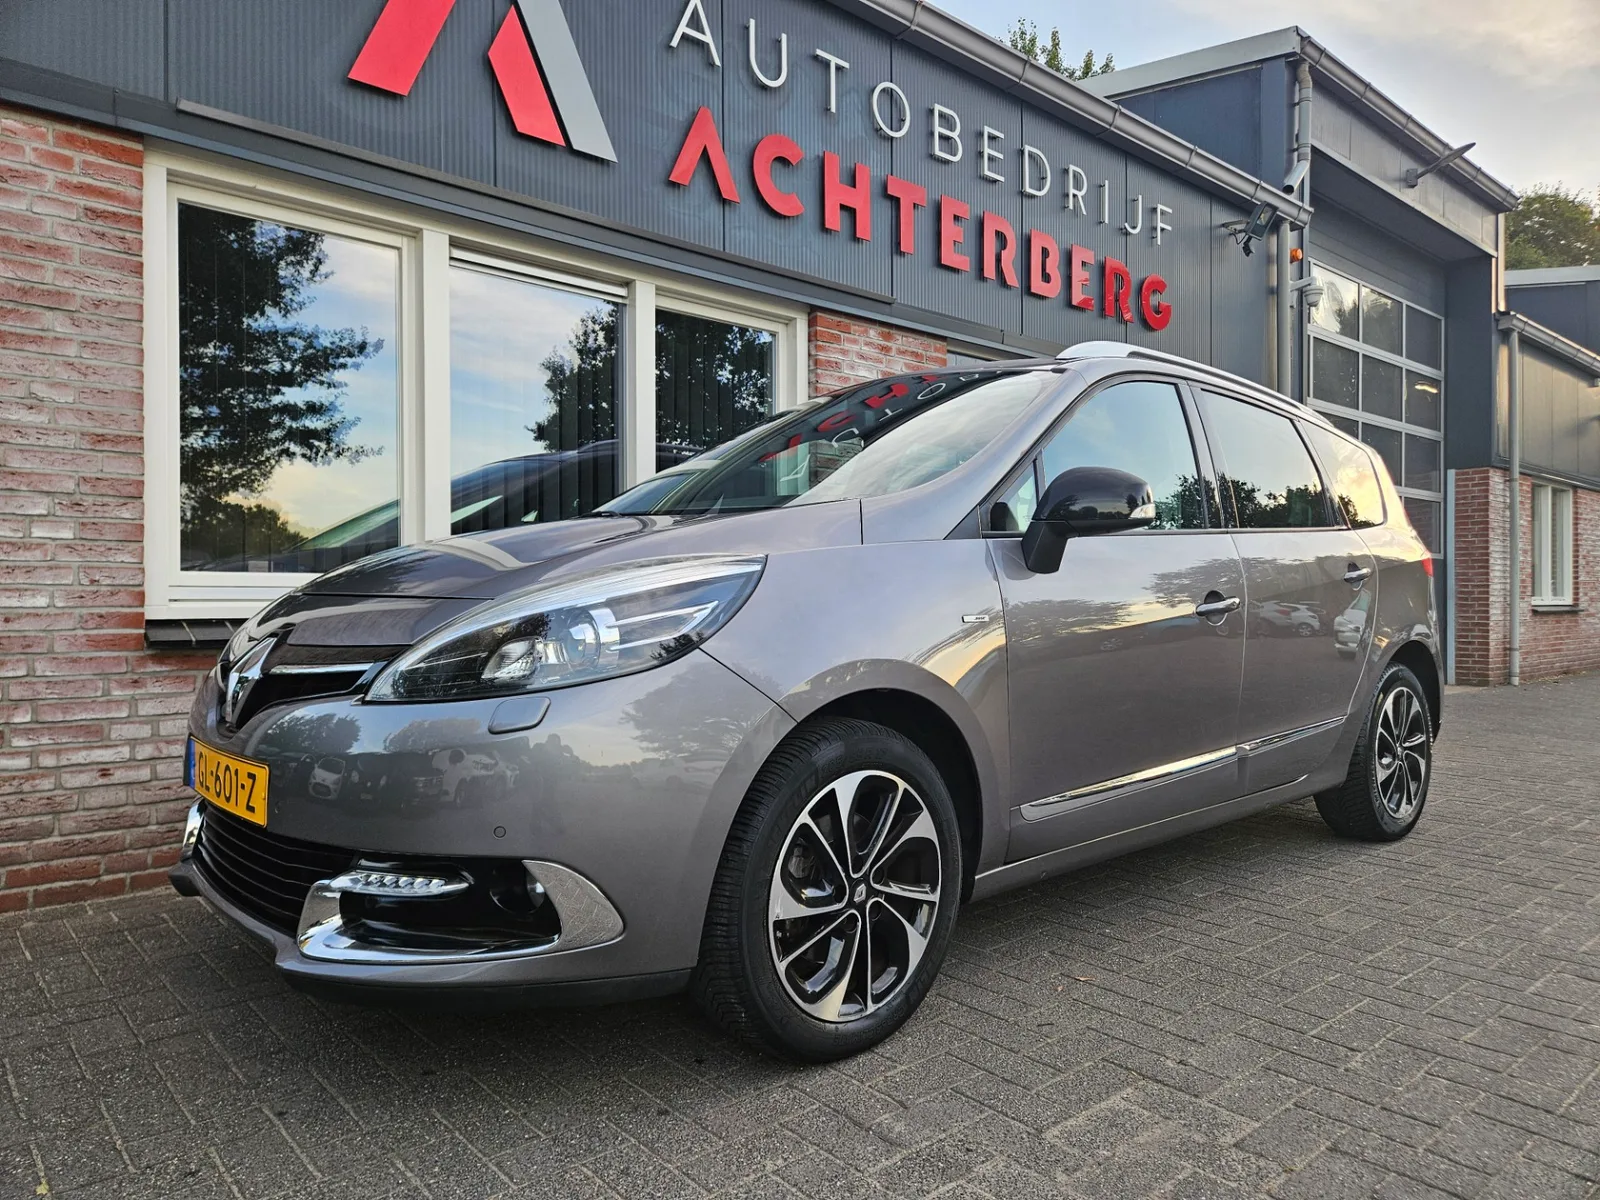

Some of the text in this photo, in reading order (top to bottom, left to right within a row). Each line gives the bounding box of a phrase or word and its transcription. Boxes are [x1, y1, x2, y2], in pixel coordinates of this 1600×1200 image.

[668, 105, 1172, 331] ACHTERBERG
[669, 0, 1173, 246] AUTOBEDRIJF
[198, 751, 257, 813] GL-601-Z
